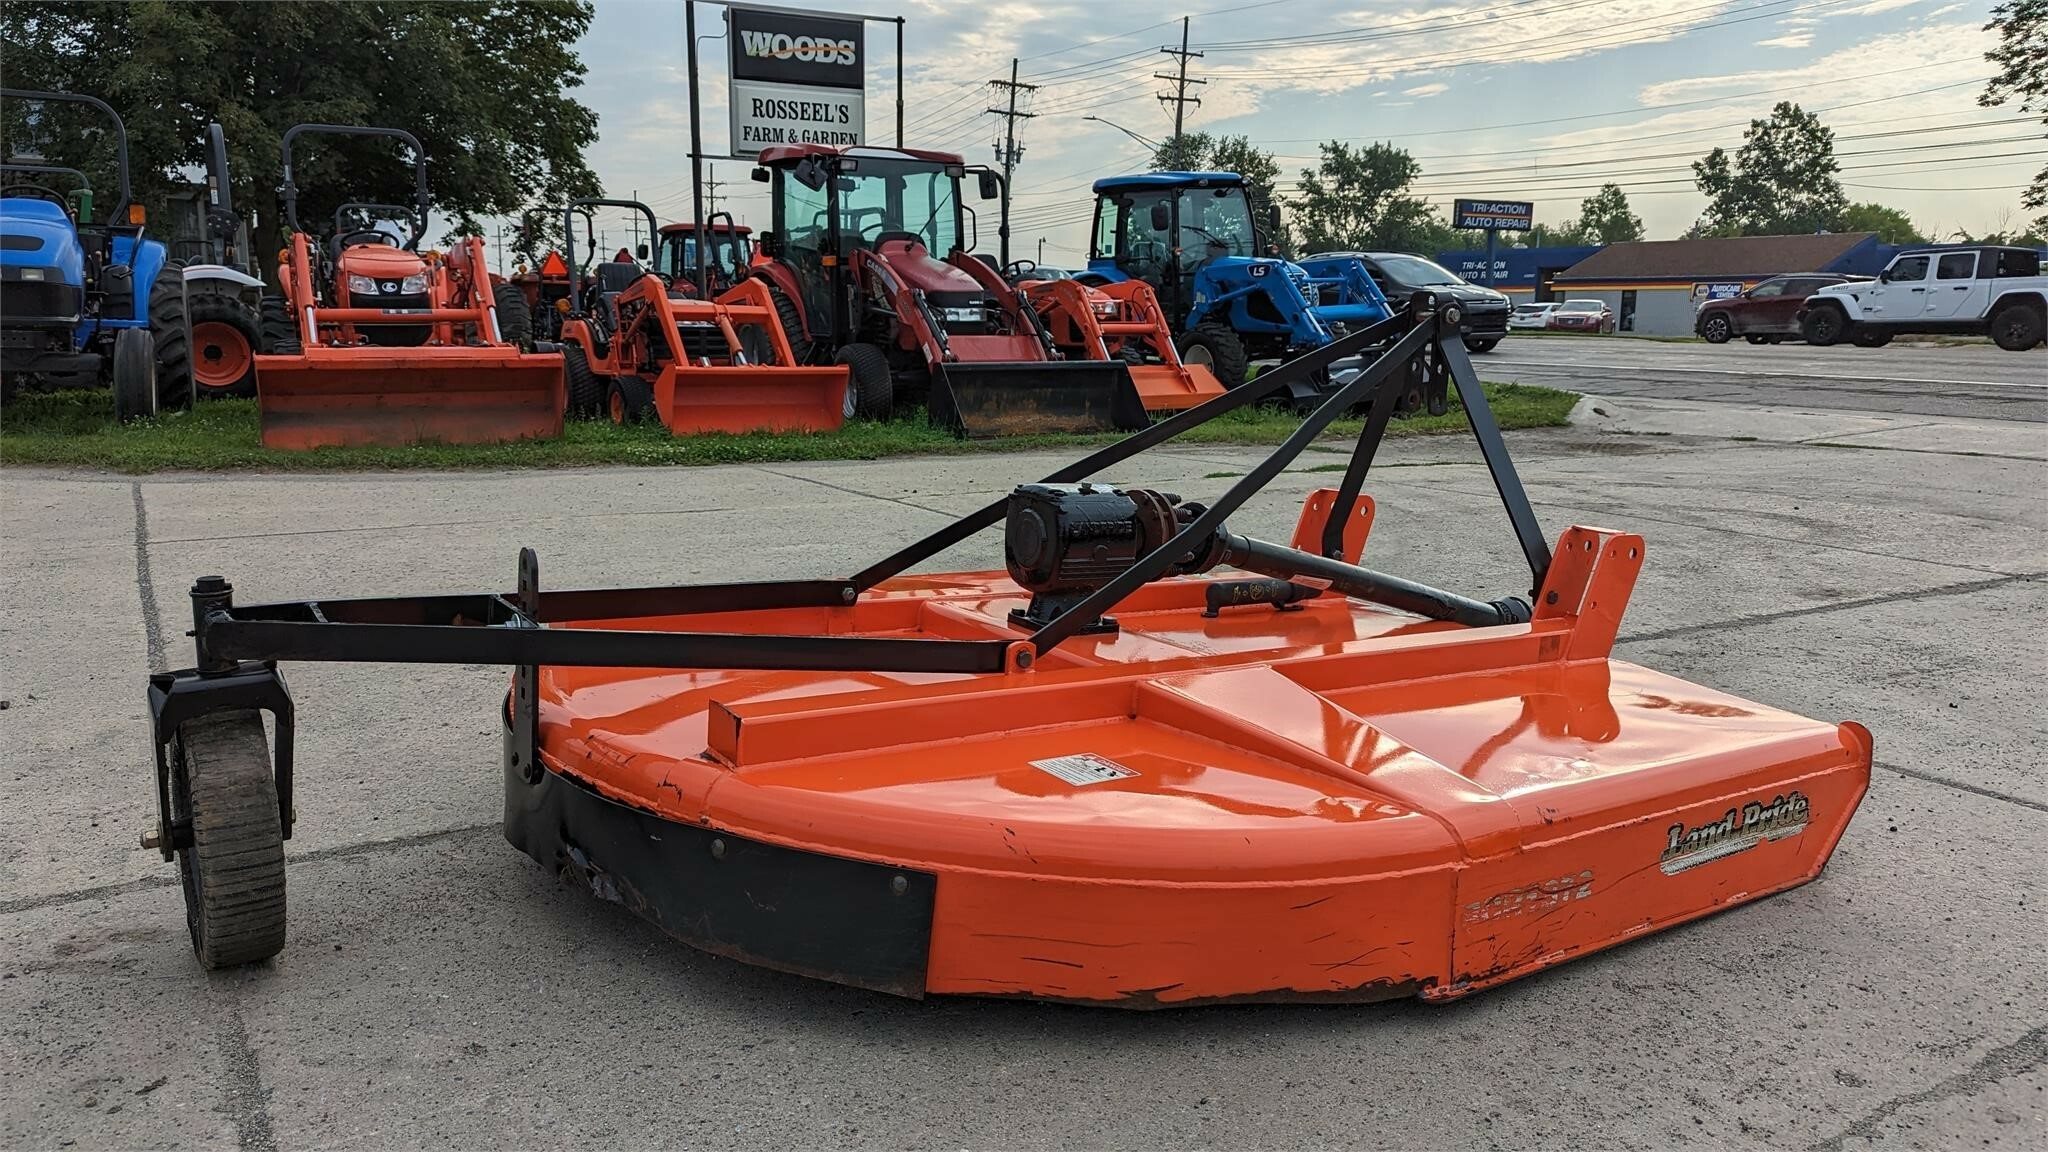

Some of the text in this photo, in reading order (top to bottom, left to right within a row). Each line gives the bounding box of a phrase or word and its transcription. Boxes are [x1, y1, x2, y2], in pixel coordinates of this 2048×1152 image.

[741, 30, 856, 65] WOODS
[751, 98, 849, 124] ROSSEEL'S
[743, 126, 858, 146] FARM & GARDEN
[1464, 217, 1529, 228] AUTO REPAIR
[1253, 266, 1265, 276] LS
[1462, 261, 1506, 269] TRI-ACON
[1663, 792, 1808, 857] Land Pride
